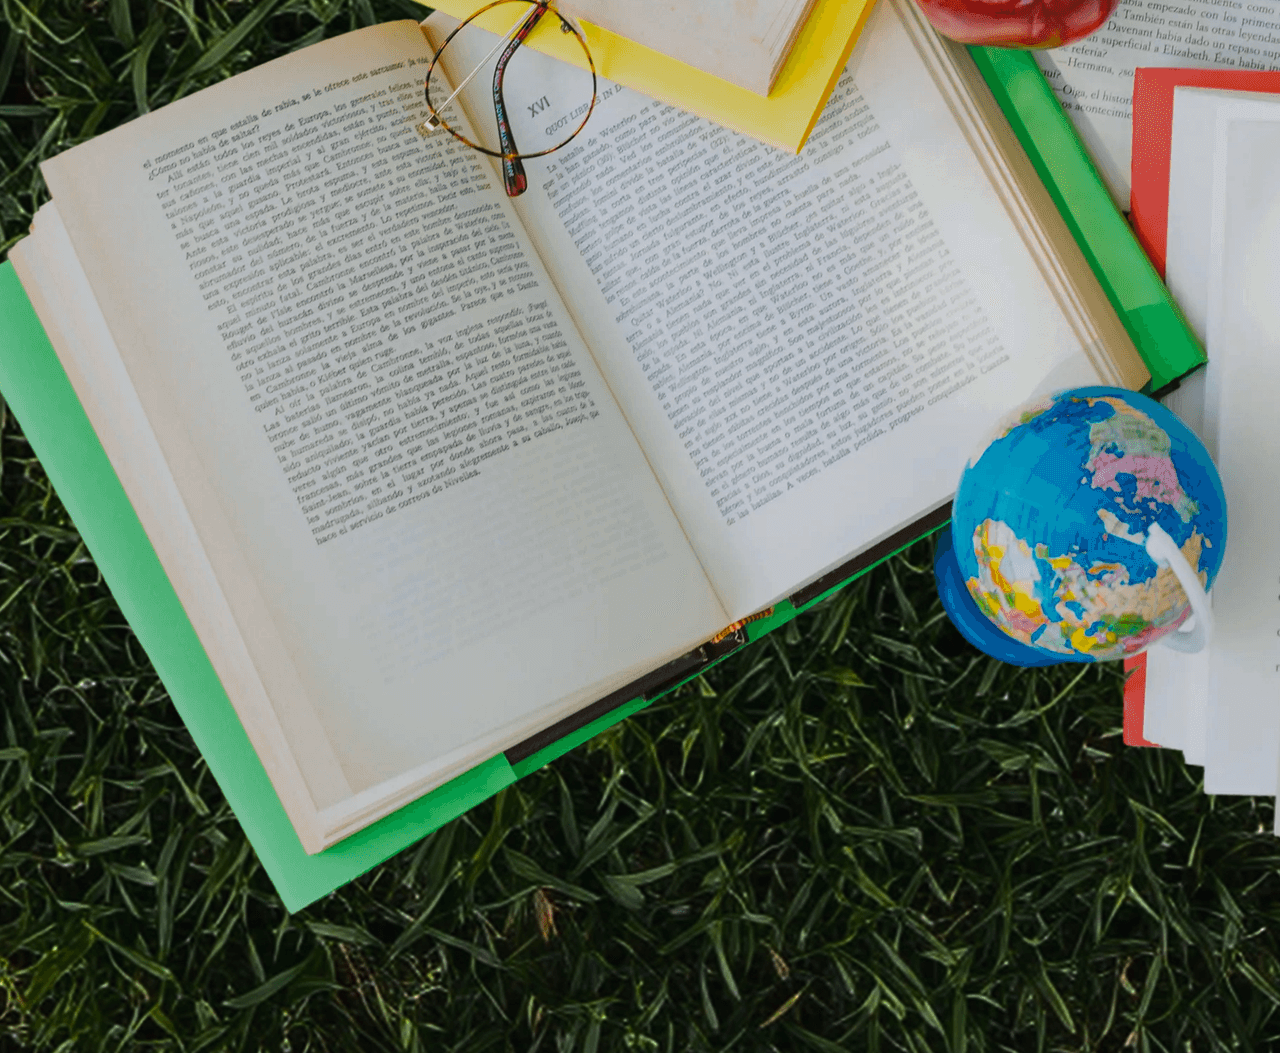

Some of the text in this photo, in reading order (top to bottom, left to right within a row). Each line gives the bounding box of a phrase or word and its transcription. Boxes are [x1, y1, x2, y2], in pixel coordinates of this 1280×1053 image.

[526, 95, 551, 118] XVI
[544, 115, 568, 136] QUOT
[601, 87, 613, 100] IN
[314, 468, 481, 546] hace el servicio de correos de Nivelles.
